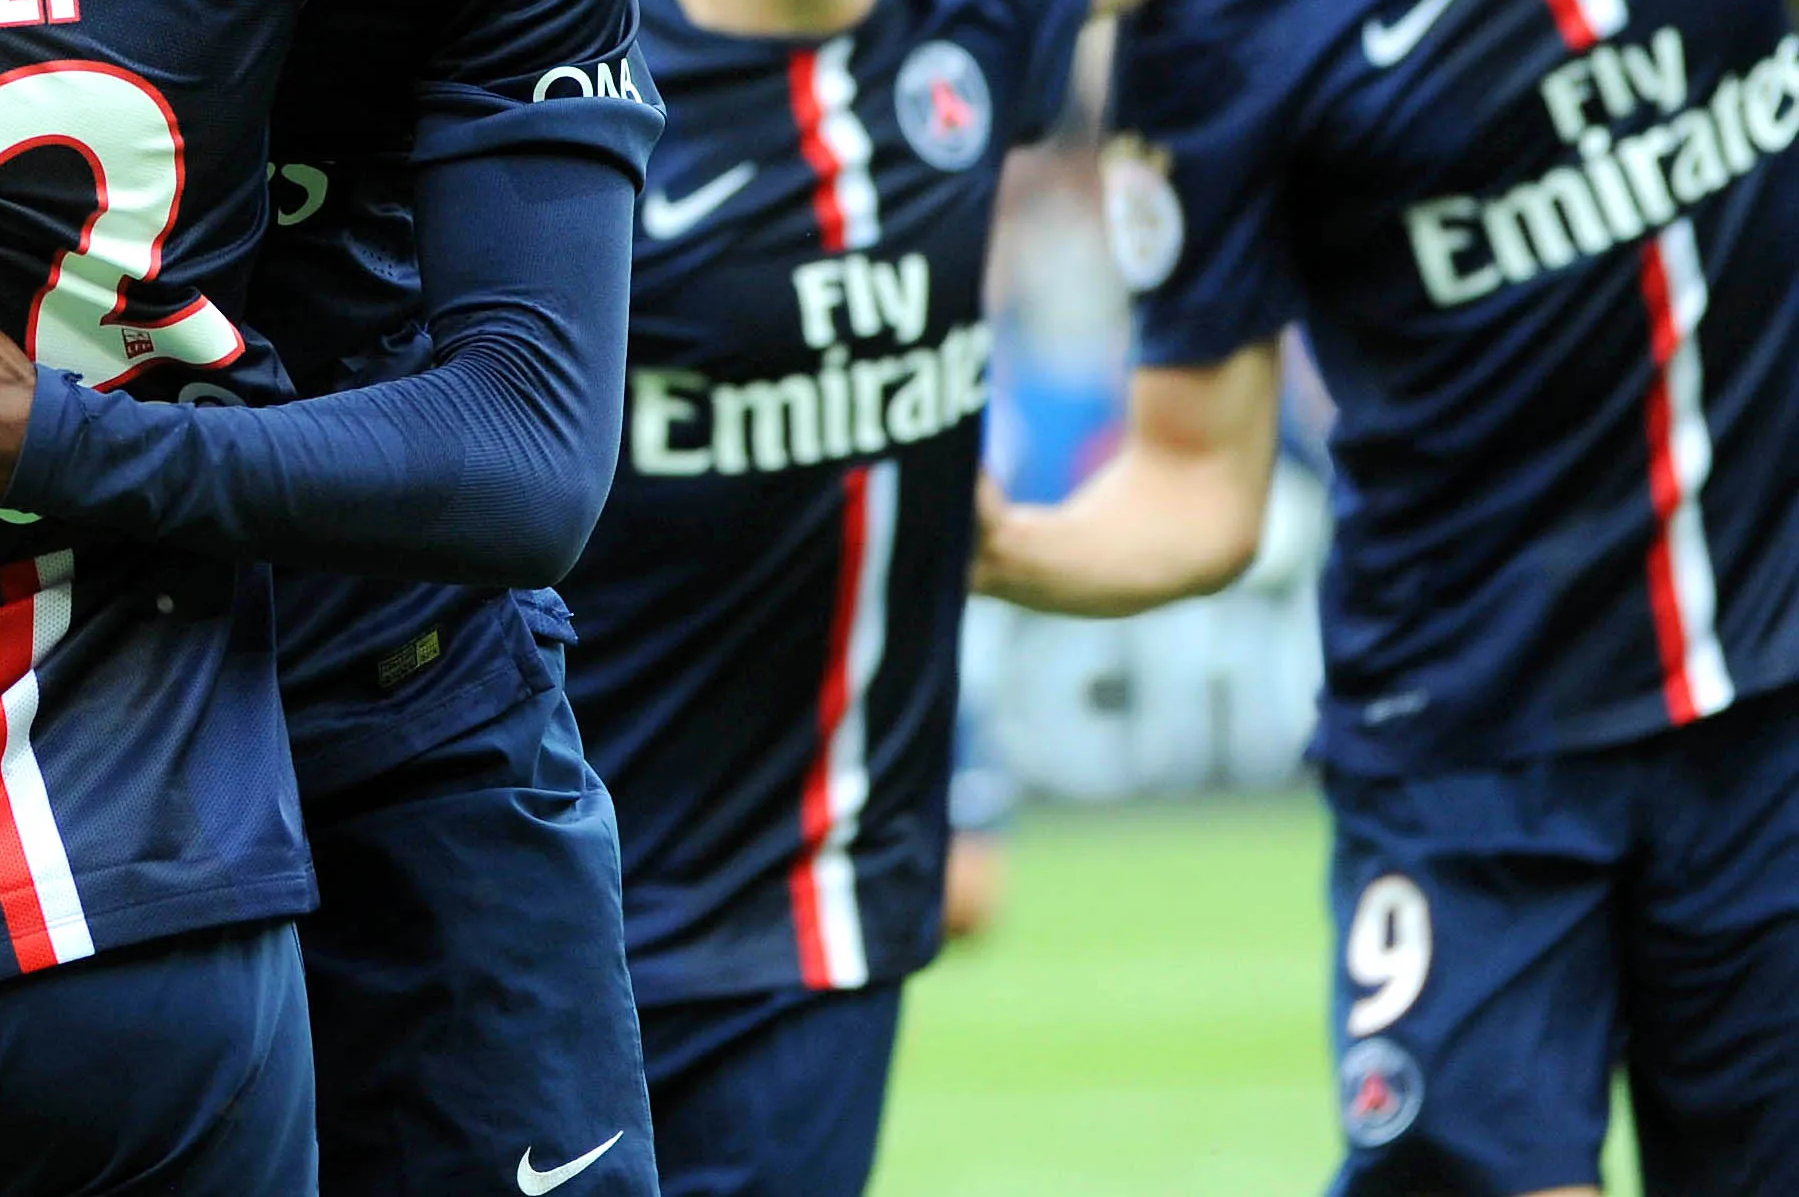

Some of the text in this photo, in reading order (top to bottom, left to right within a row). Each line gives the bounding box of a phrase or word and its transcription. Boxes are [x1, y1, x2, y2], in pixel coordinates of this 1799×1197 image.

[1540, 26, 1688, 143] Fly
[792, 252, 929, 348] Fly
[1347, 872, 1433, 1039] 9
